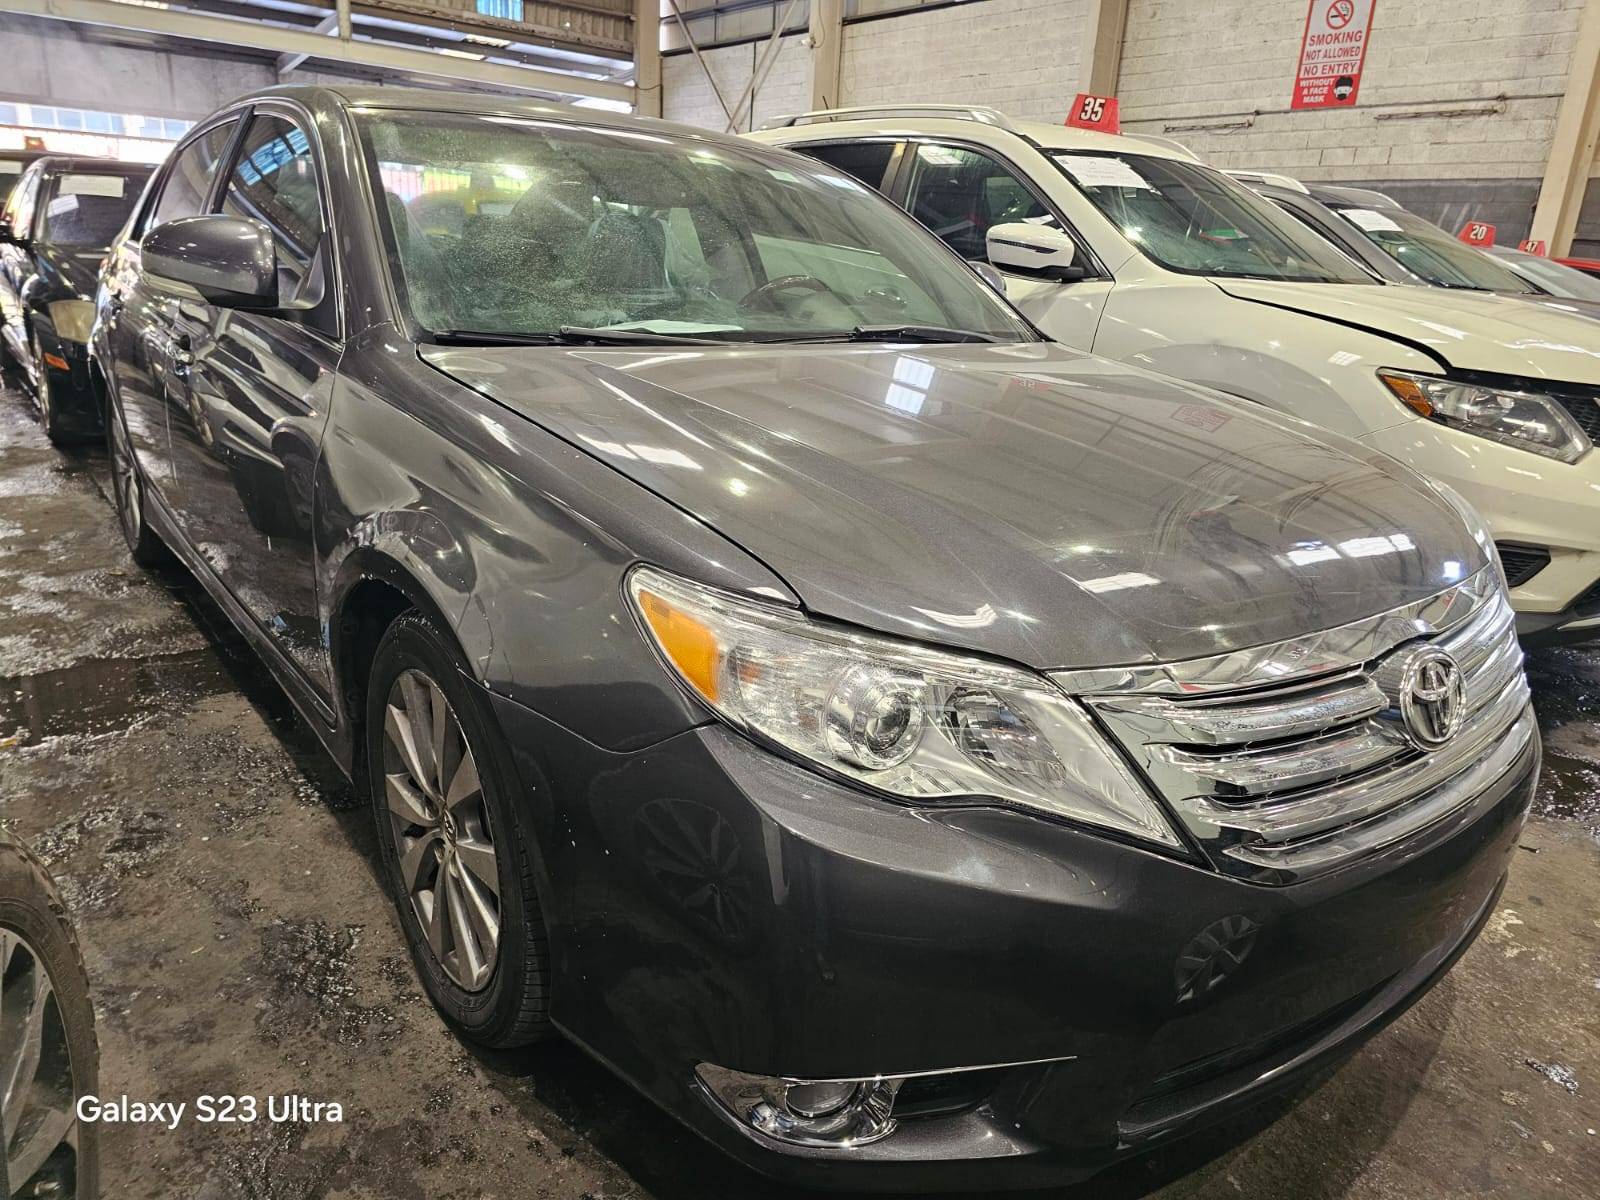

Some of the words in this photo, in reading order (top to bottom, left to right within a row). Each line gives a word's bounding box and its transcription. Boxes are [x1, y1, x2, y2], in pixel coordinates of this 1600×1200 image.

[1309, 31, 1363, 46] SMOKING
[1306, 50, 1321, 60] NOT
[1322, 46, 1360, 59] ALLOWED
[1303, 65, 1318, 76] NO
[1321, 62, 1357, 75] ENTRY
[1300, 78, 1335, 87] WITHOUT
[1309, 87, 1328, 95] FACE
[1303, 95, 1325, 103] MASK
[1080, 97, 1106, 122] 35
[1469, 225, 1487, 240] 20
